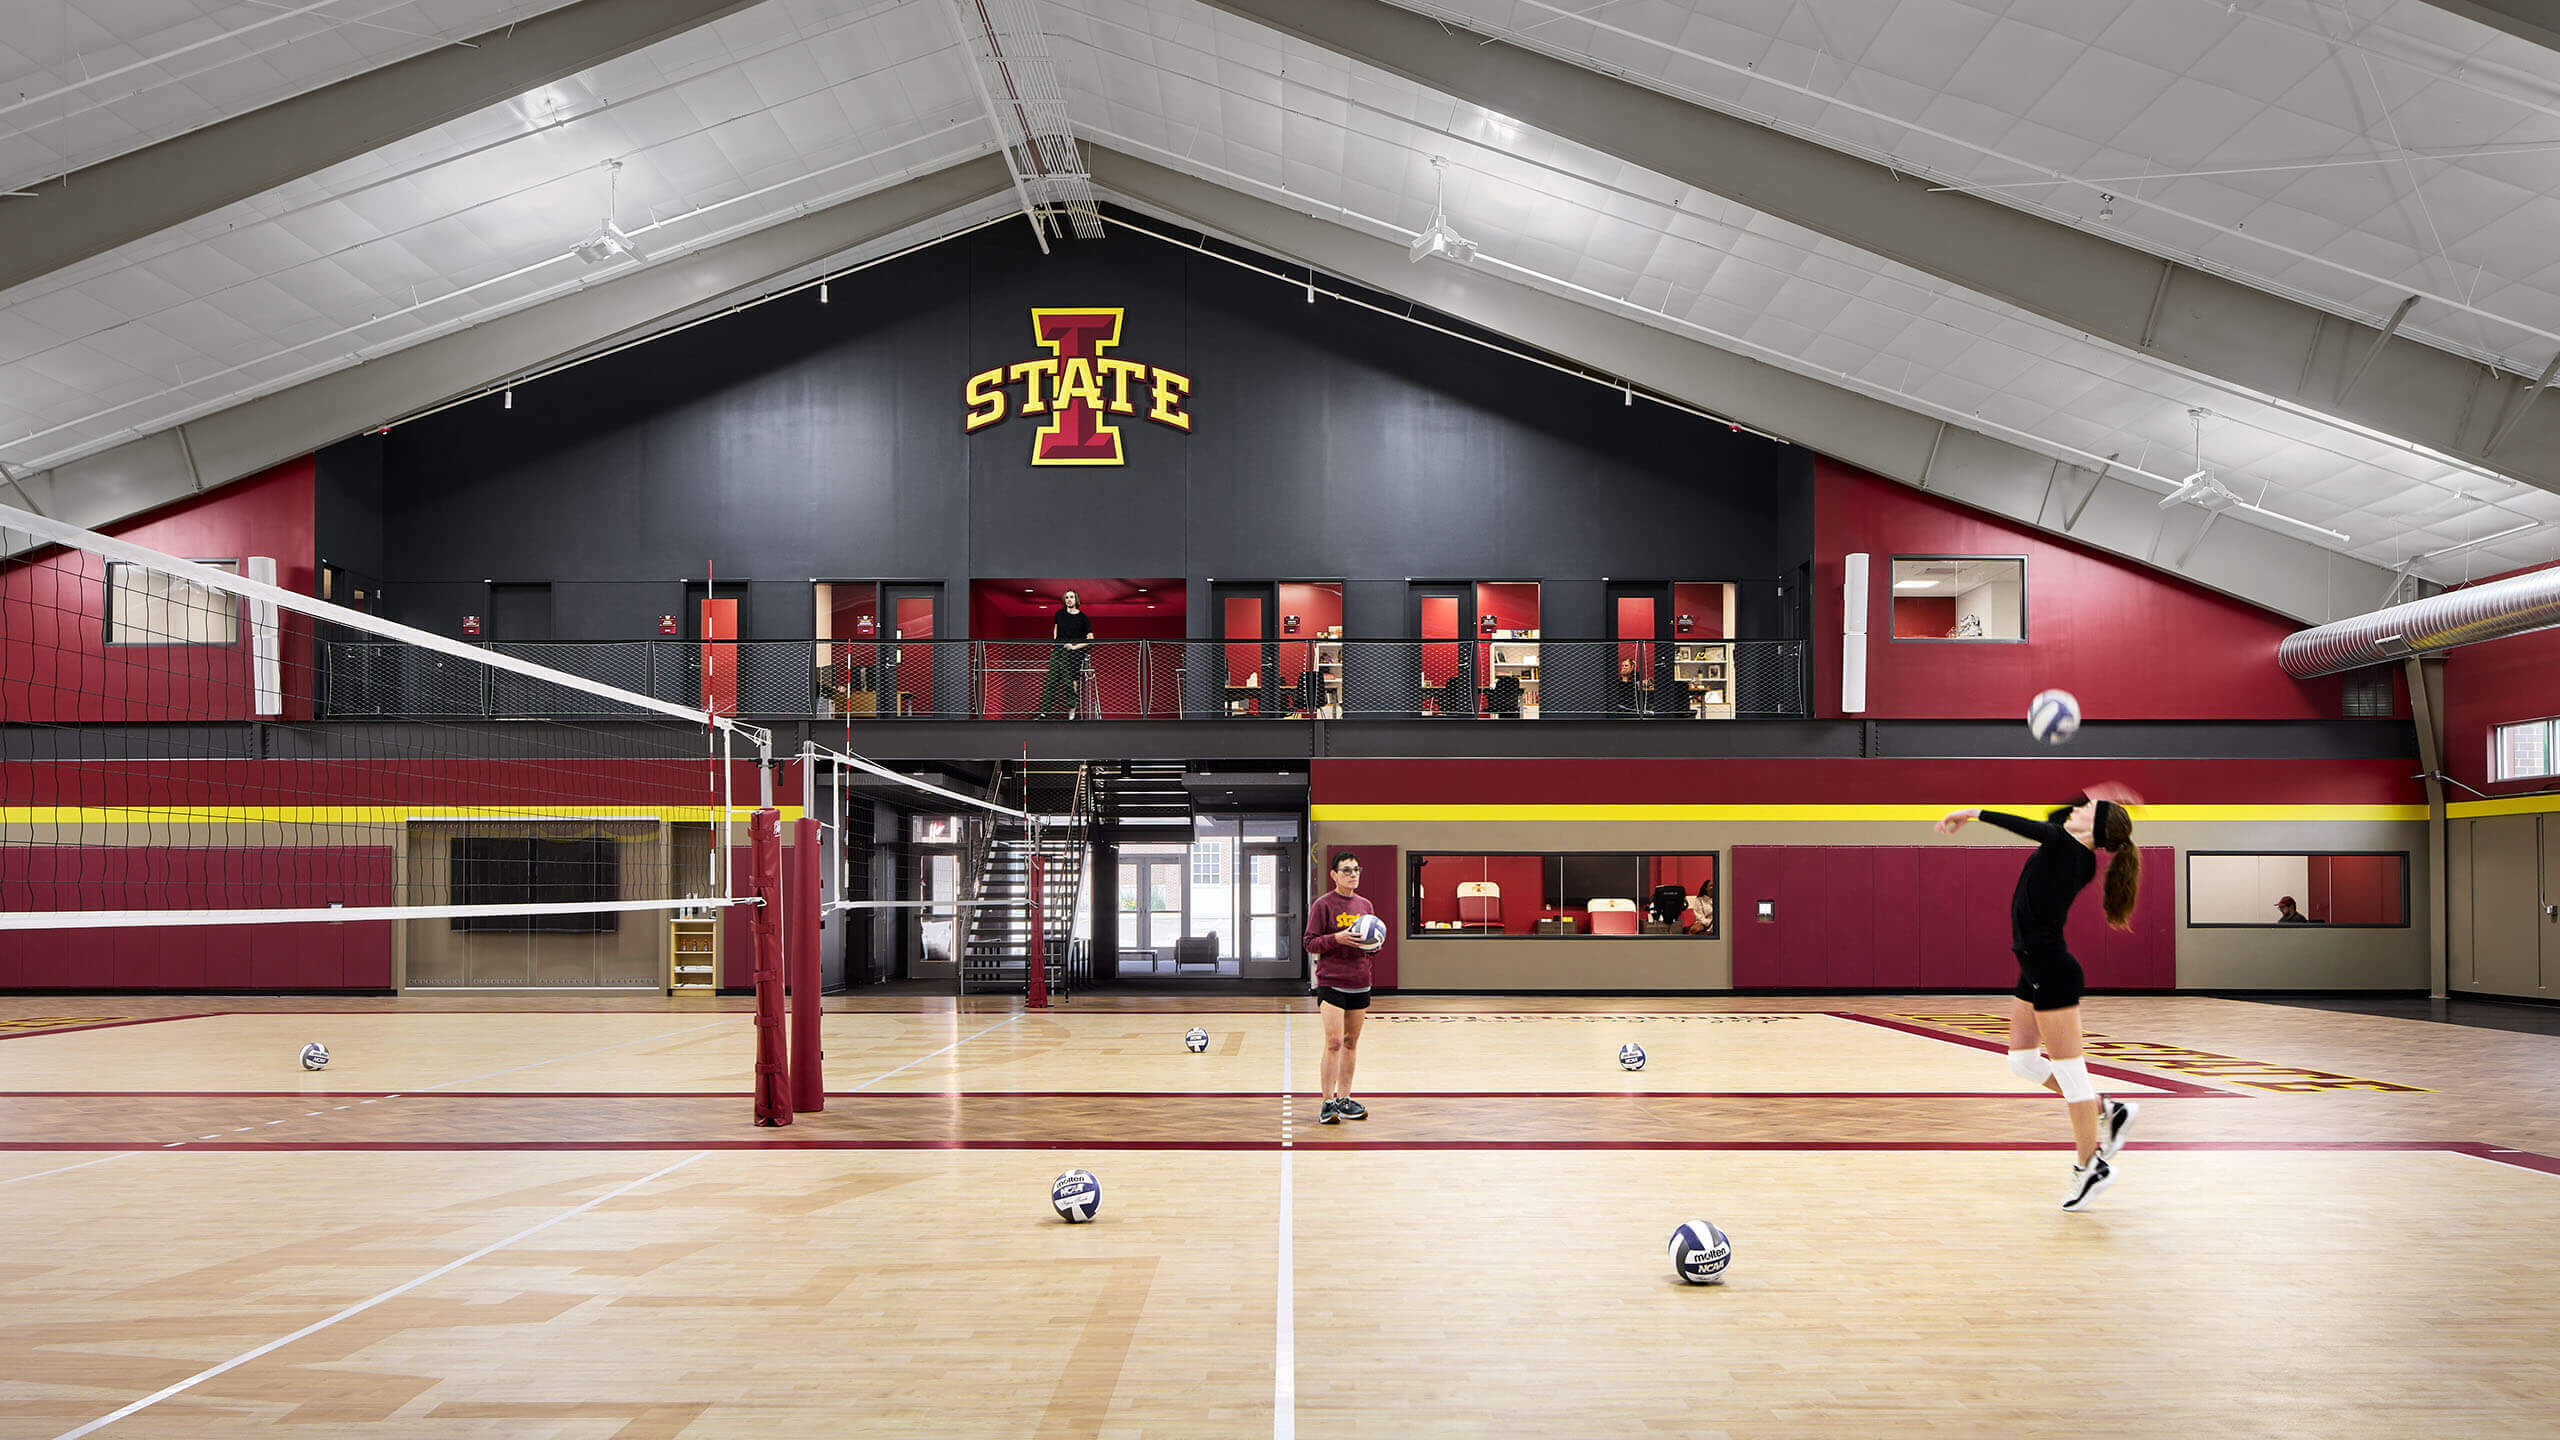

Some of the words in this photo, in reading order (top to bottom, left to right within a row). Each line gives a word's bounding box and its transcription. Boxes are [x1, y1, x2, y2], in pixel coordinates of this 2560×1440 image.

[965, 356, 1192, 433] STATE
[1056, 1176, 1085, 1188] molten
[1694, 1247, 1727, 1263] molten
[1698, 1259, 1725, 1273] NCAA
